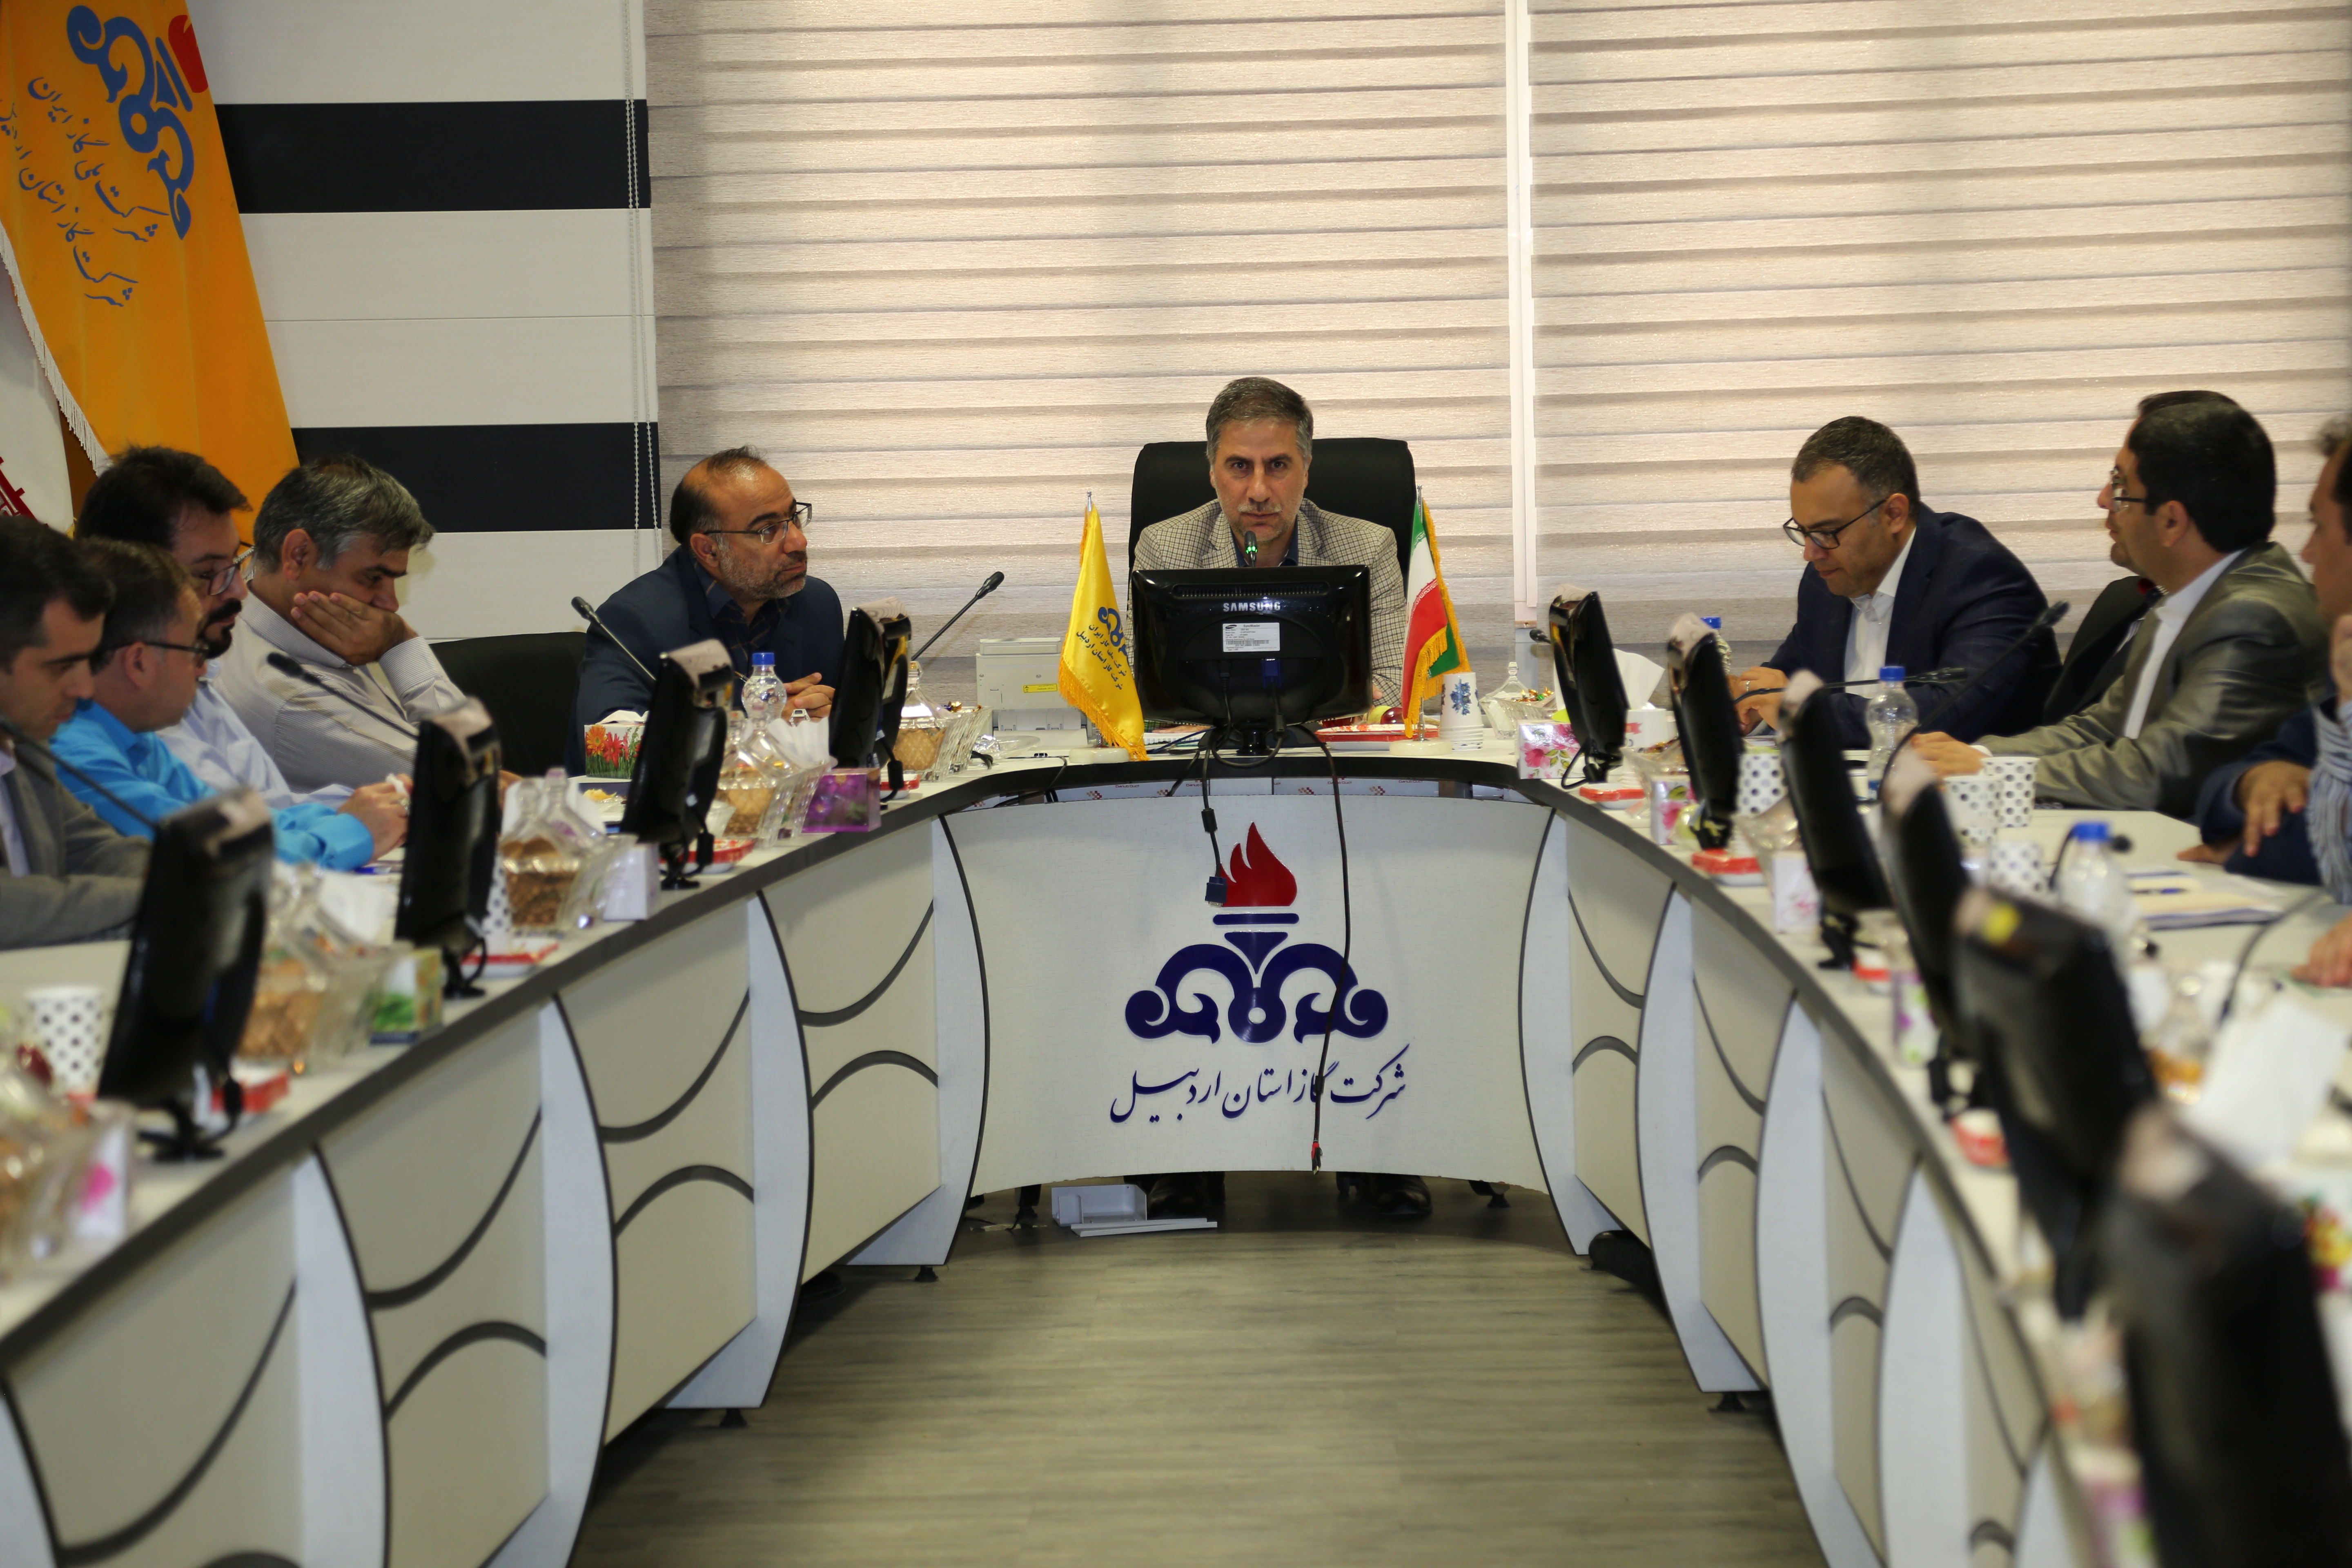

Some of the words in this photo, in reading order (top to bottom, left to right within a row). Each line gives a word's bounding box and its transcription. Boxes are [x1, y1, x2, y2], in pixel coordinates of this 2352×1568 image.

[28, 77, 74, 123] ایران
[66, 118, 110, 154] گاز
[19, 168, 66, 213] استان
[95, 180, 169, 242] شرکت
[57, 207, 95, 242] گاز
[73, 245, 138, 307] شرکت
[1223, 601, 1281, 612] SAMSUNG
[1110, 1068, 1221, 1123] اردبیل
[1222, 1068, 1292, 1118] استان
[1330, 1043, 1410, 1119] شرکت
